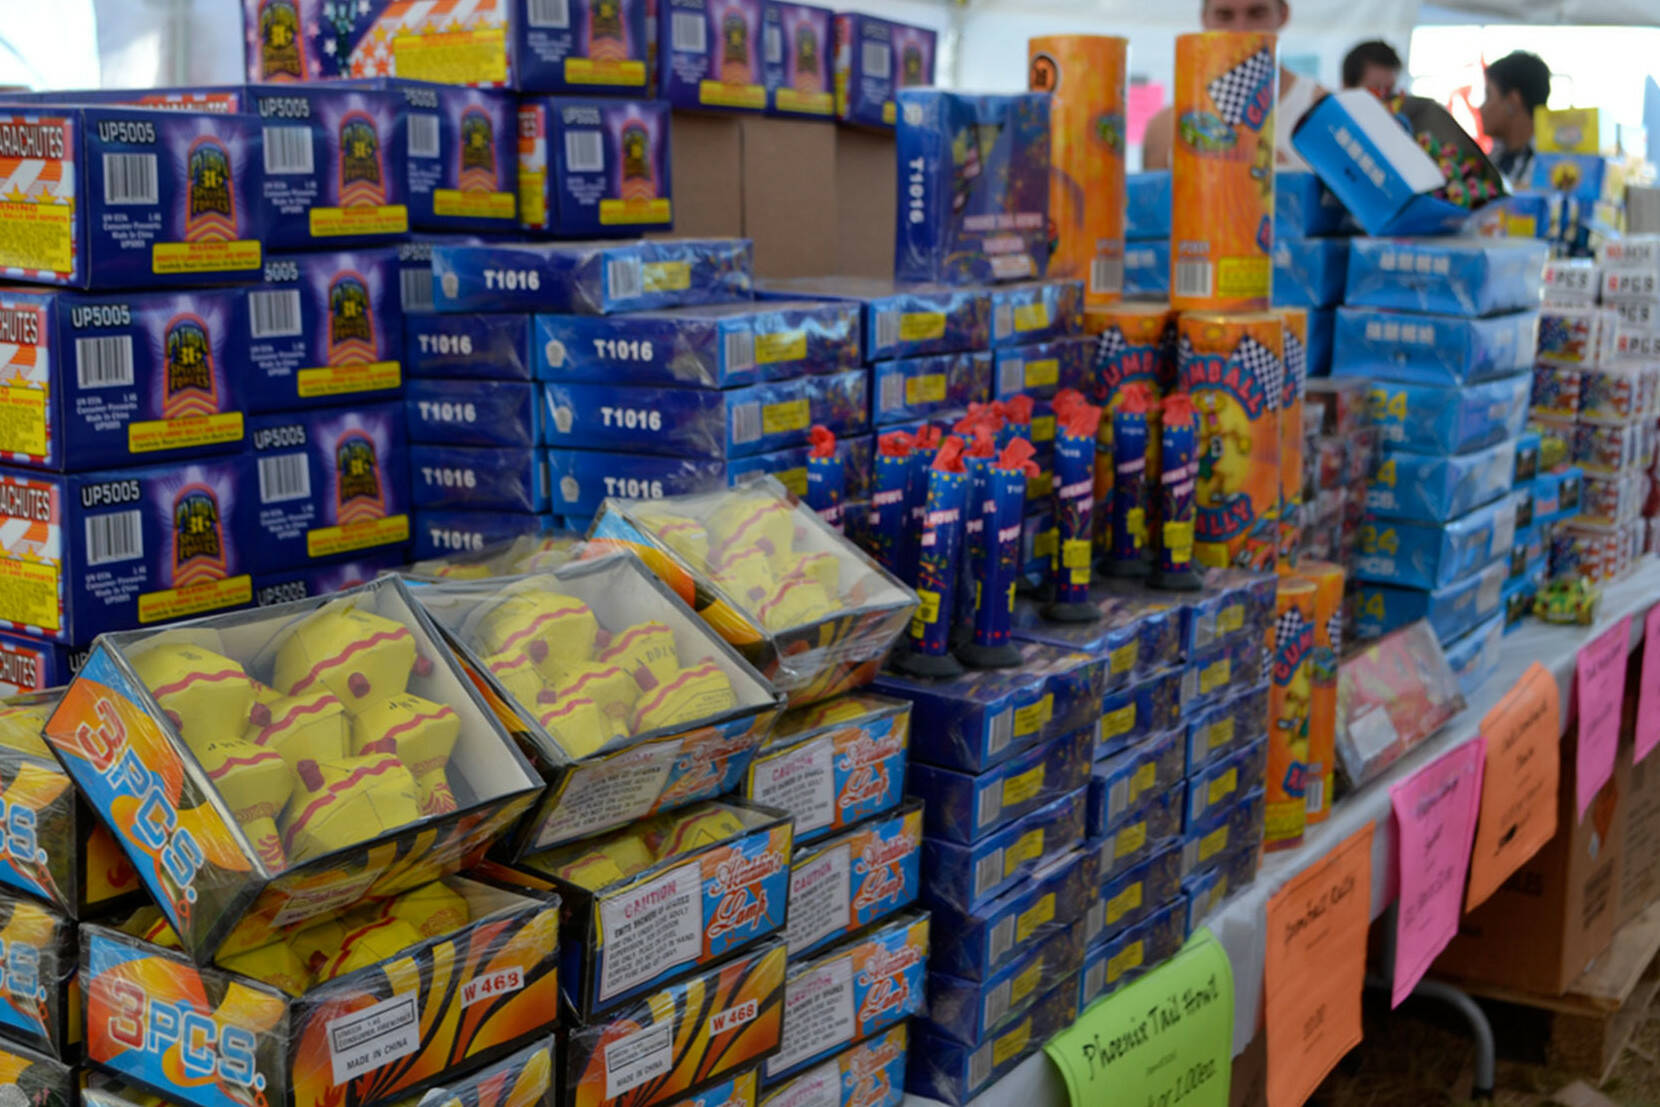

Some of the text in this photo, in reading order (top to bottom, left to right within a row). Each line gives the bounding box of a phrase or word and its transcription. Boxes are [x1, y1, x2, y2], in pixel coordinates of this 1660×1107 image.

[259, 98, 310, 118] UP5005
[98, 122, 156, 143] UP5005
[263, 261, 299, 283] 5005
[484, 270, 541, 291] T1016
[72, 305, 131, 327] UP5005
[417, 334, 473, 355] T1016
[593, 339, 654, 361] T1016
[418, 401, 477, 423] T1016
[601, 406, 662, 431] T1016
[254, 425, 306, 449] UP5005
[422, 467, 477, 488] T1016
[603, 476, 663, 498] T1016
[81, 480, 140, 506] UP5005
[430, 529, 484, 551] T1016
[624, 880, 676, 919] CAUTION
[713, 1018, 725, 1031] W
[346, 1037, 407, 1070] MADE IN CHINA
